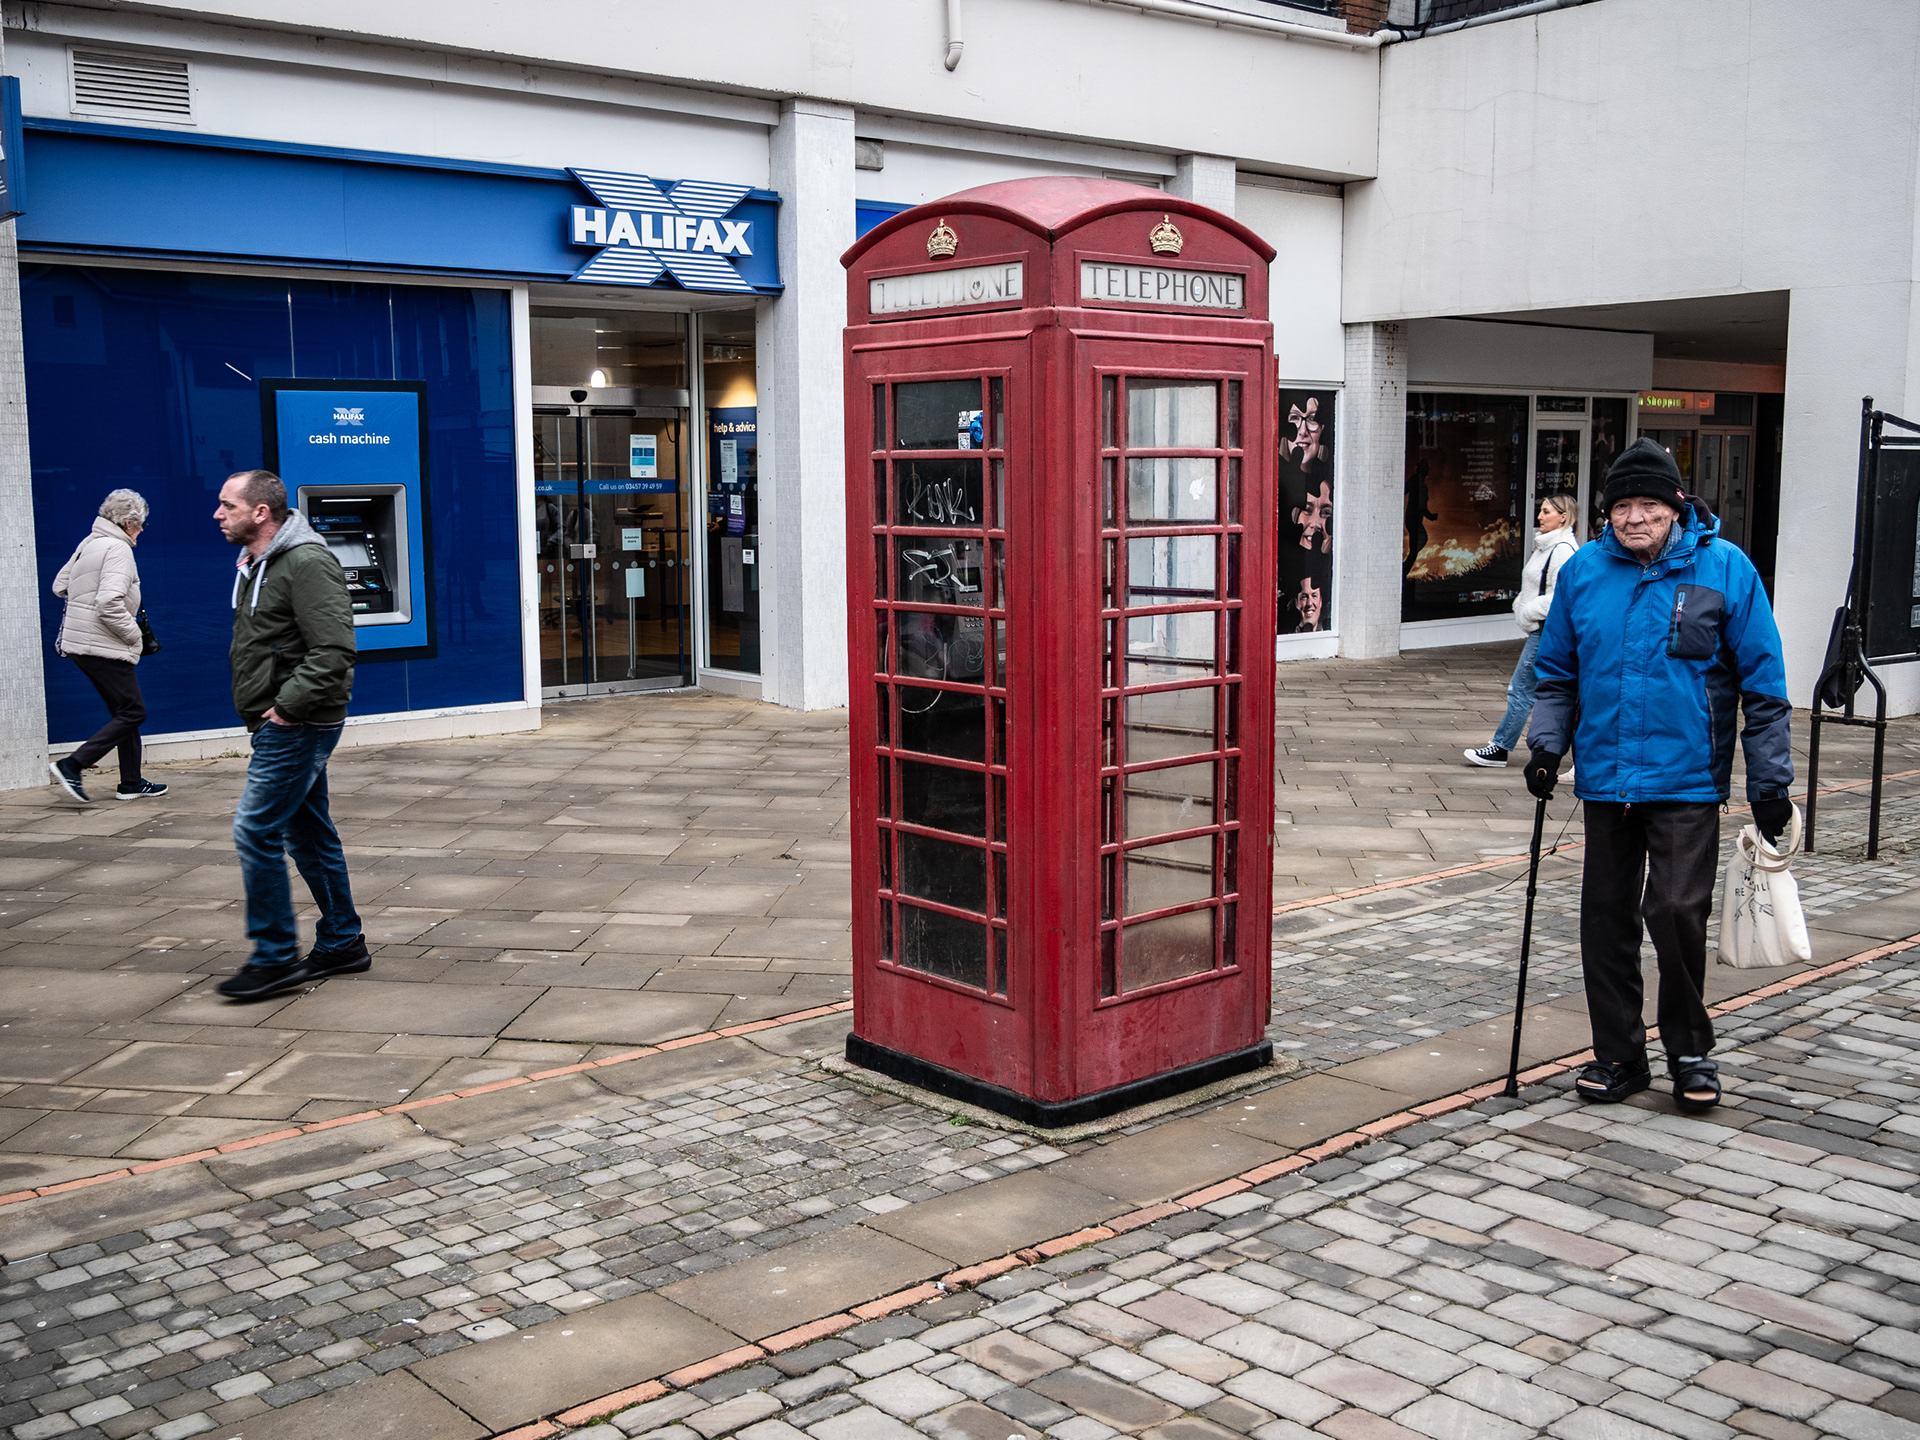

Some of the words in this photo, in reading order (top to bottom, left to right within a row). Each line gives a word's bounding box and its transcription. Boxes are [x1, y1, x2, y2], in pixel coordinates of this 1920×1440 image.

[573, 207, 753, 256] HALIFAX
[1087, 266, 1237, 306] TELEPHONE
[1646, 395, 1686, 409] Shopping
[333, 413, 365, 421] HALIFAX
[713, 422, 728, 435] help
[729, 421, 735, 433] &
[735, 421, 756, 433] advice
[309, 433, 337, 444] cash
[340, 433, 391, 445] machine
[1563, 472, 1576, 489] 50
